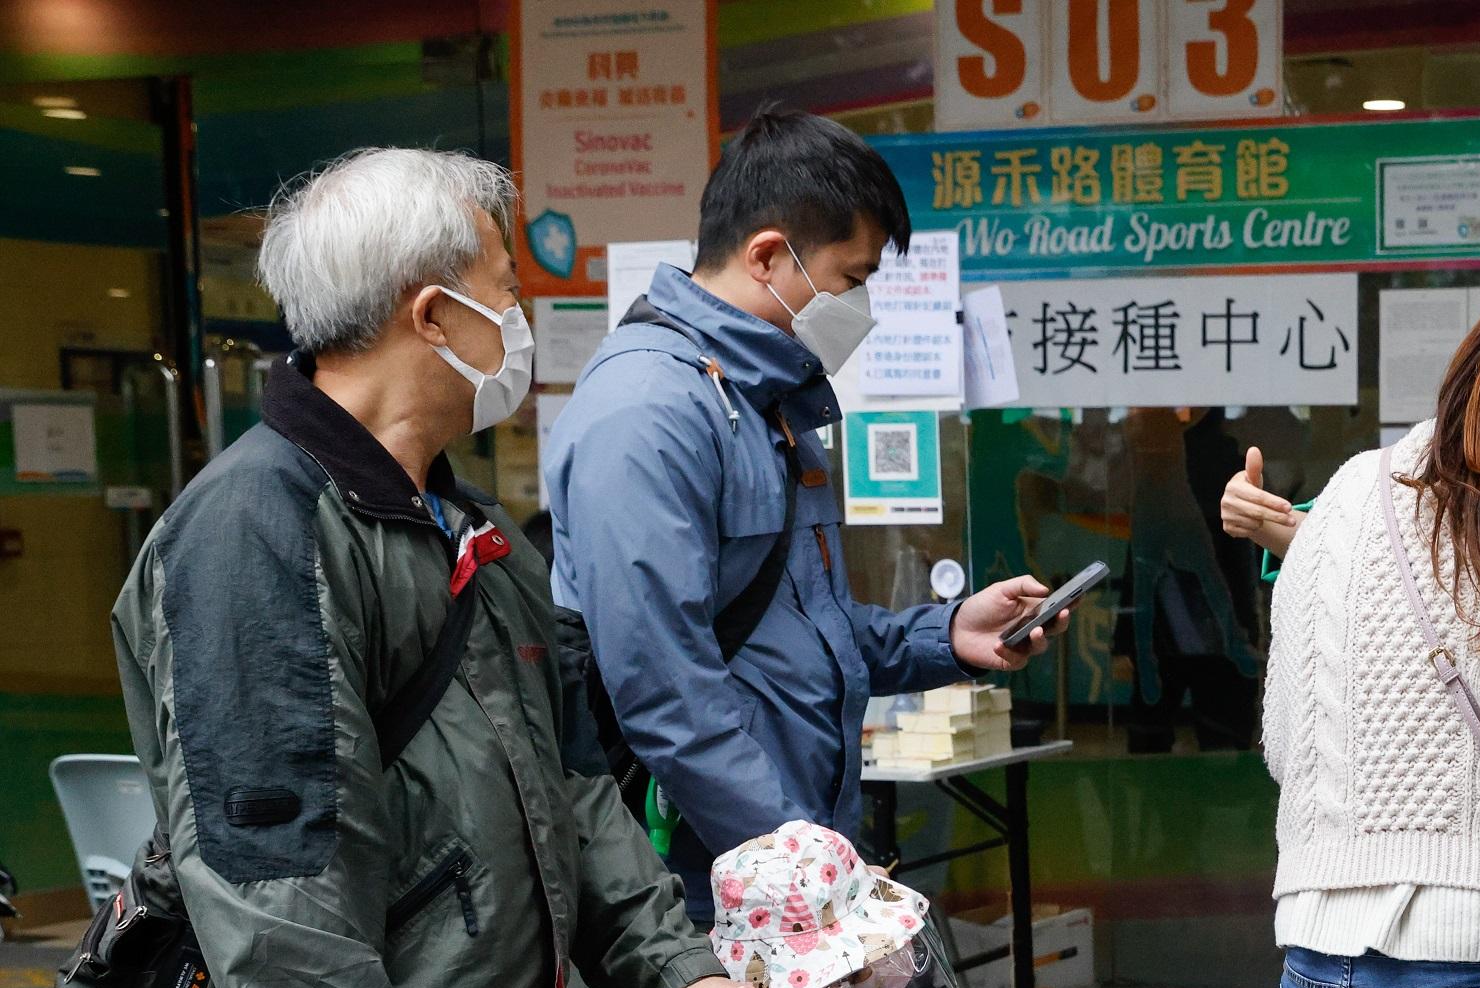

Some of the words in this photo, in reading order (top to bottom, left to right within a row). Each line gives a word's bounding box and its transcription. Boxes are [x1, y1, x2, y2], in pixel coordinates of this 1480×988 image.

[574, 130, 653, 152] Sinovac
[931, 139, 1291, 208] 源禾路體育館
[957, 214, 1017, 258] Wo
[1025, 212, 1114, 256] Road
[1125, 211, 1233, 263] Sports
[1244, 207, 1352, 253] Centre
[1004, 297, 1351, 378] 接種中心
